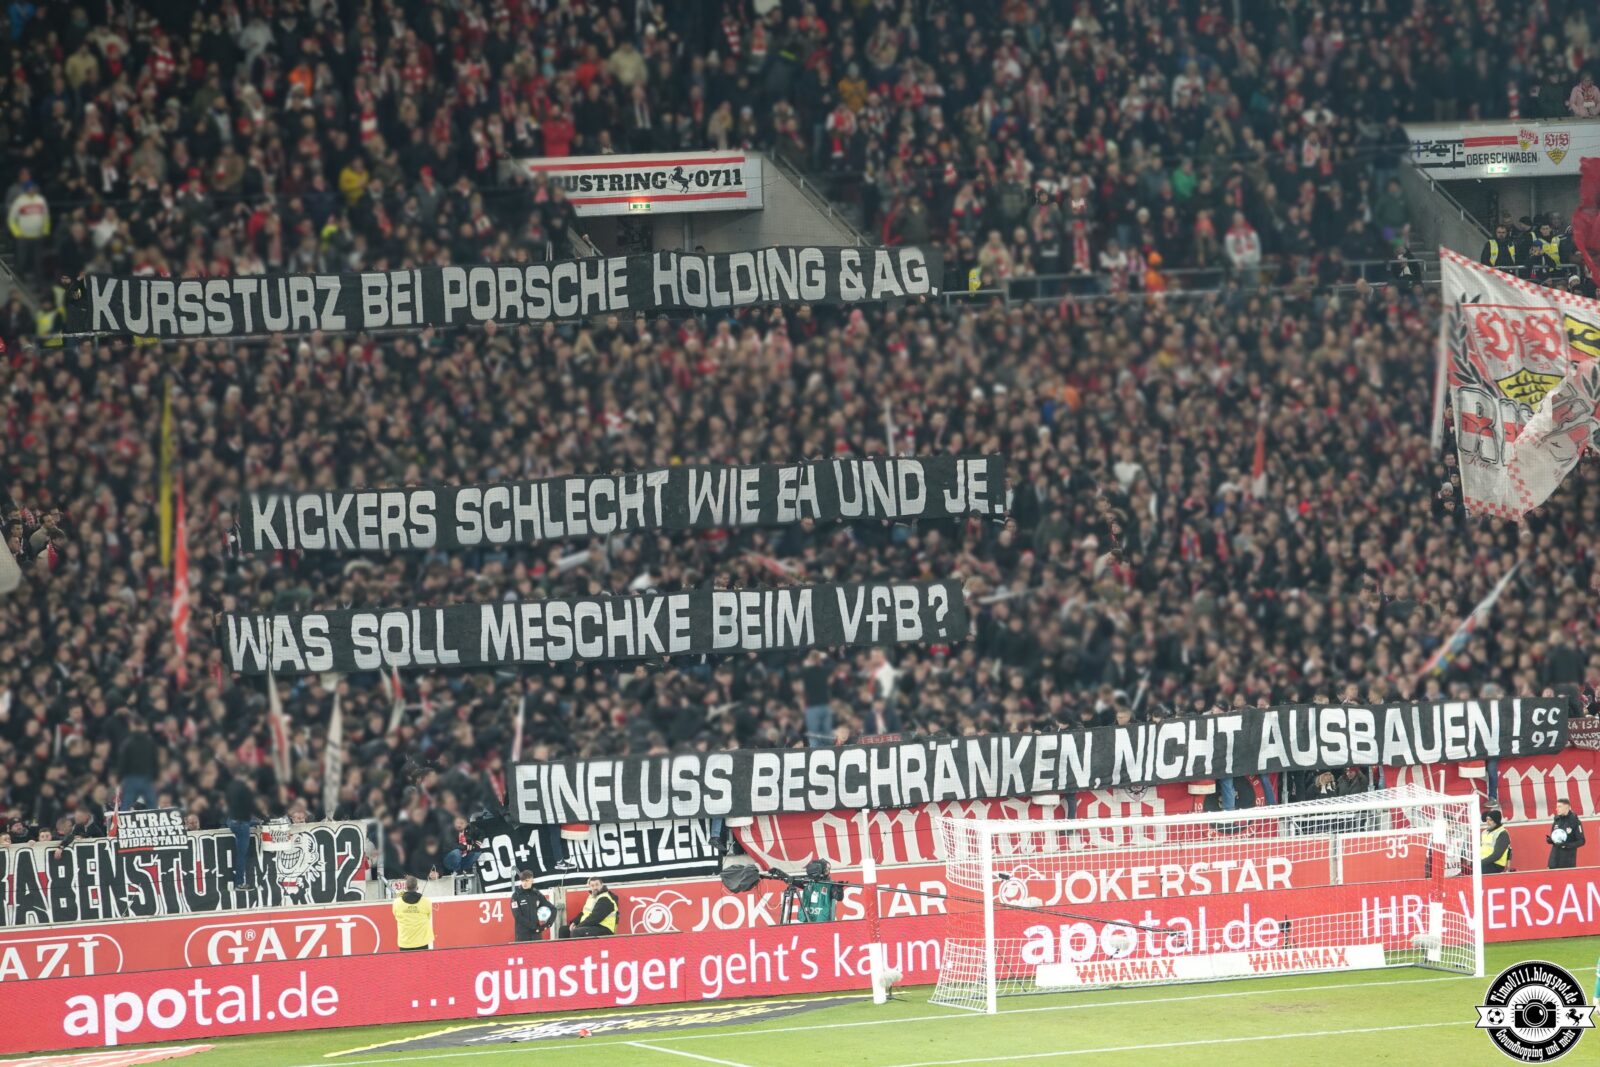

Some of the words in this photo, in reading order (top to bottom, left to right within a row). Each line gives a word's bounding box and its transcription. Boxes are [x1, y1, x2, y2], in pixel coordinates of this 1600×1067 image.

[1467, 152, 1538, 165] OBERSCHWABEN
[695, 168, 743, 188] 0711
[91, 274, 347, 336] KURSSTURZ
[361, 269, 424, 328] BEI
[442, 256, 629, 324] PORSCHE
[653, 247, 827, 308] HOLDING
[250, 490, 438, 551] KICKERS
[455, 469, 670, 545] SCHLECHT
[688, 467, 761, 527] WIE
[833, 458, 928, 518] UND
[942, 458, 1005, 515] JE.
[227, 614, 334, 672] WAS
[351, 608, 461, 670] SOLL
[480, 593, 692, 662] MESCHKE
[712, 588, 816, 650] BEIM
[1531, 706, 1561, 726] CC
[1531, 730, 1559, 748] 97
[515, 752, 735, 825] EINFLUSS
[751, 731, 1101, 812] BESCHRÄNKEN,
[1111, 714, 1243, 786] NICHT
[118, 811, 183, 829] ULTRAS
[118, 825, 184, 839] BEDEUTET
[119, 836, 188, 848] WIDERSTAND
[565, 818, 719, 870] MSETZEN.
[1385, 837, 1409, 859] 35
[1045, 857, 1293, 906] JOKERSTAR
[478, 901, 504, 924] 34
[1361, 893, 1449, 938] IHR
[1021, 903, 1282, 966] apotal.de
[1075, 959, 1179, 984] WINAMAX
[1248, 947, 1350, 972] WINAMAX
[474, 952, 686, 1016] günstiger
[833, 932, 943, 978] kaum
[62, 970, 340, 1046] apotal.de
